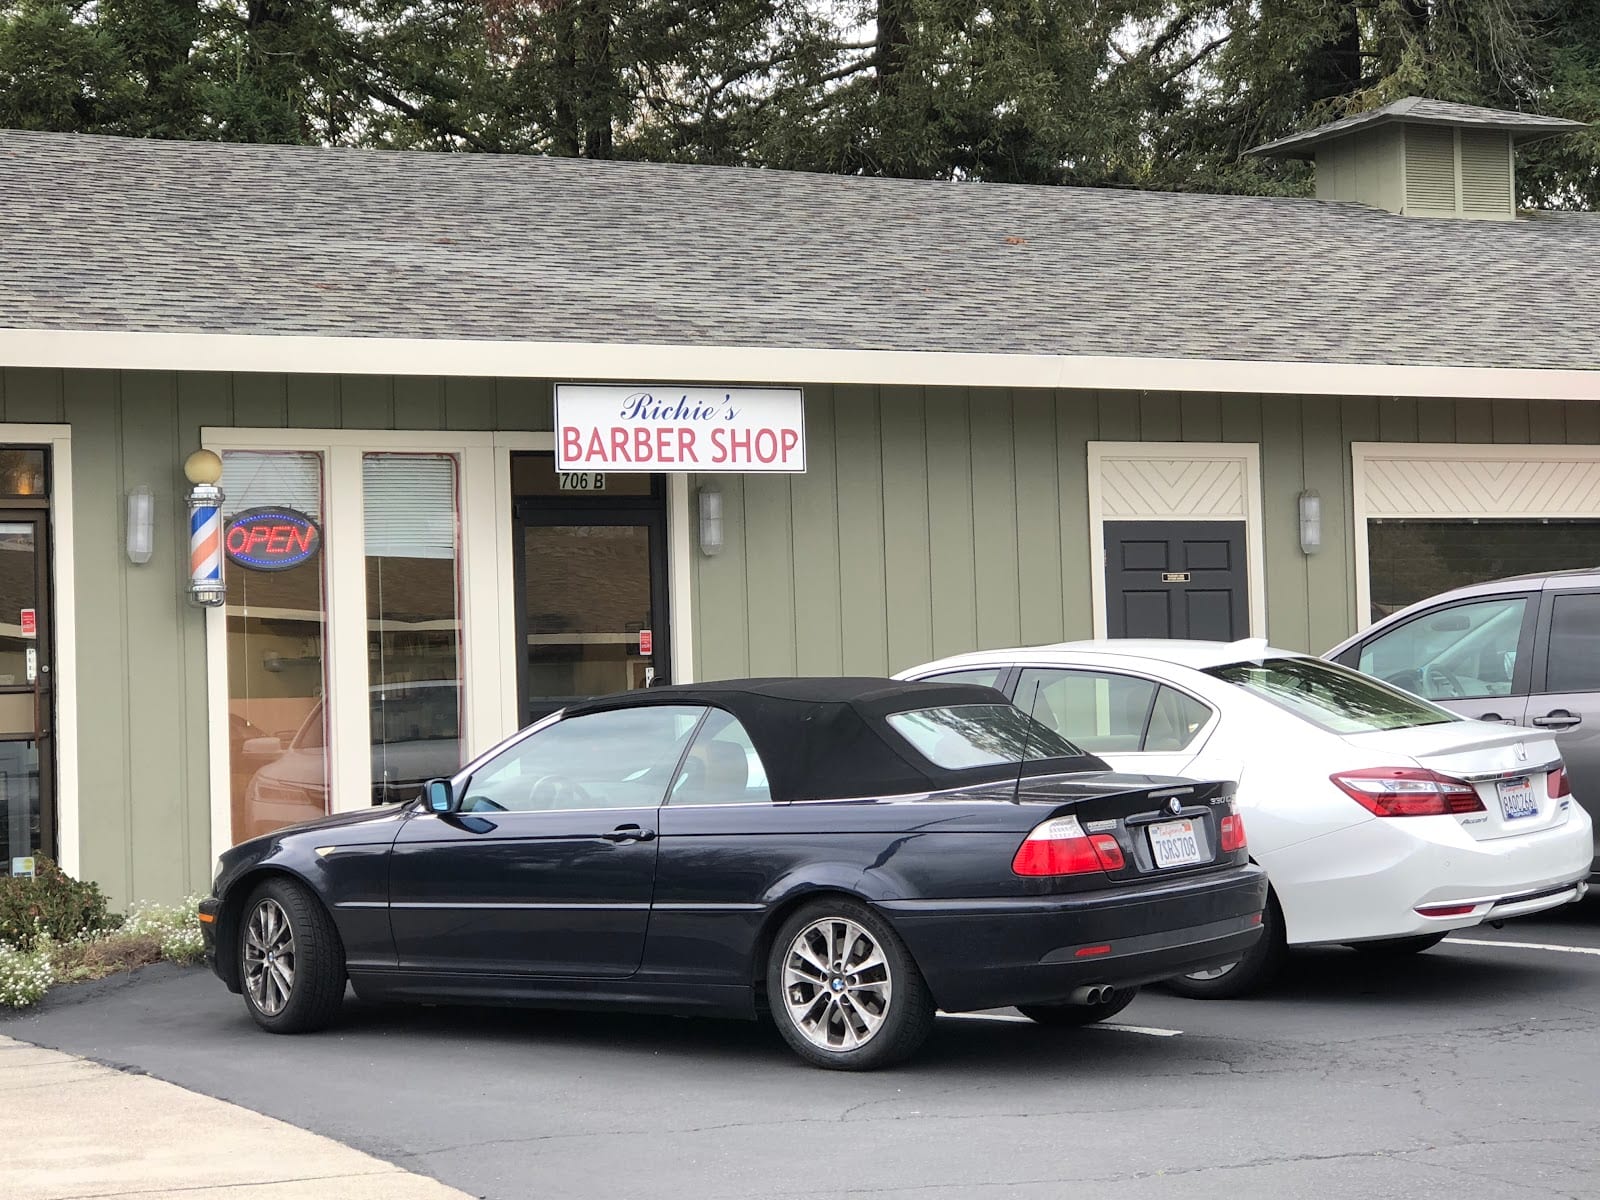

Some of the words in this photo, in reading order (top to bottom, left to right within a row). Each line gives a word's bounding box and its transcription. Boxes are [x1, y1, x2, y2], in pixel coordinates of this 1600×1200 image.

[619, 392, 742, 421] Richie's
[562, 426, 699, 463] BARBER
[710, 428, 799, 463] SHOP
[561, 472, 588, 489] 706
[594, 472, 604, 489] B
[226, 525, 315, 553] OPEN
[1156, 837, 1197, 861] 7SRS708
